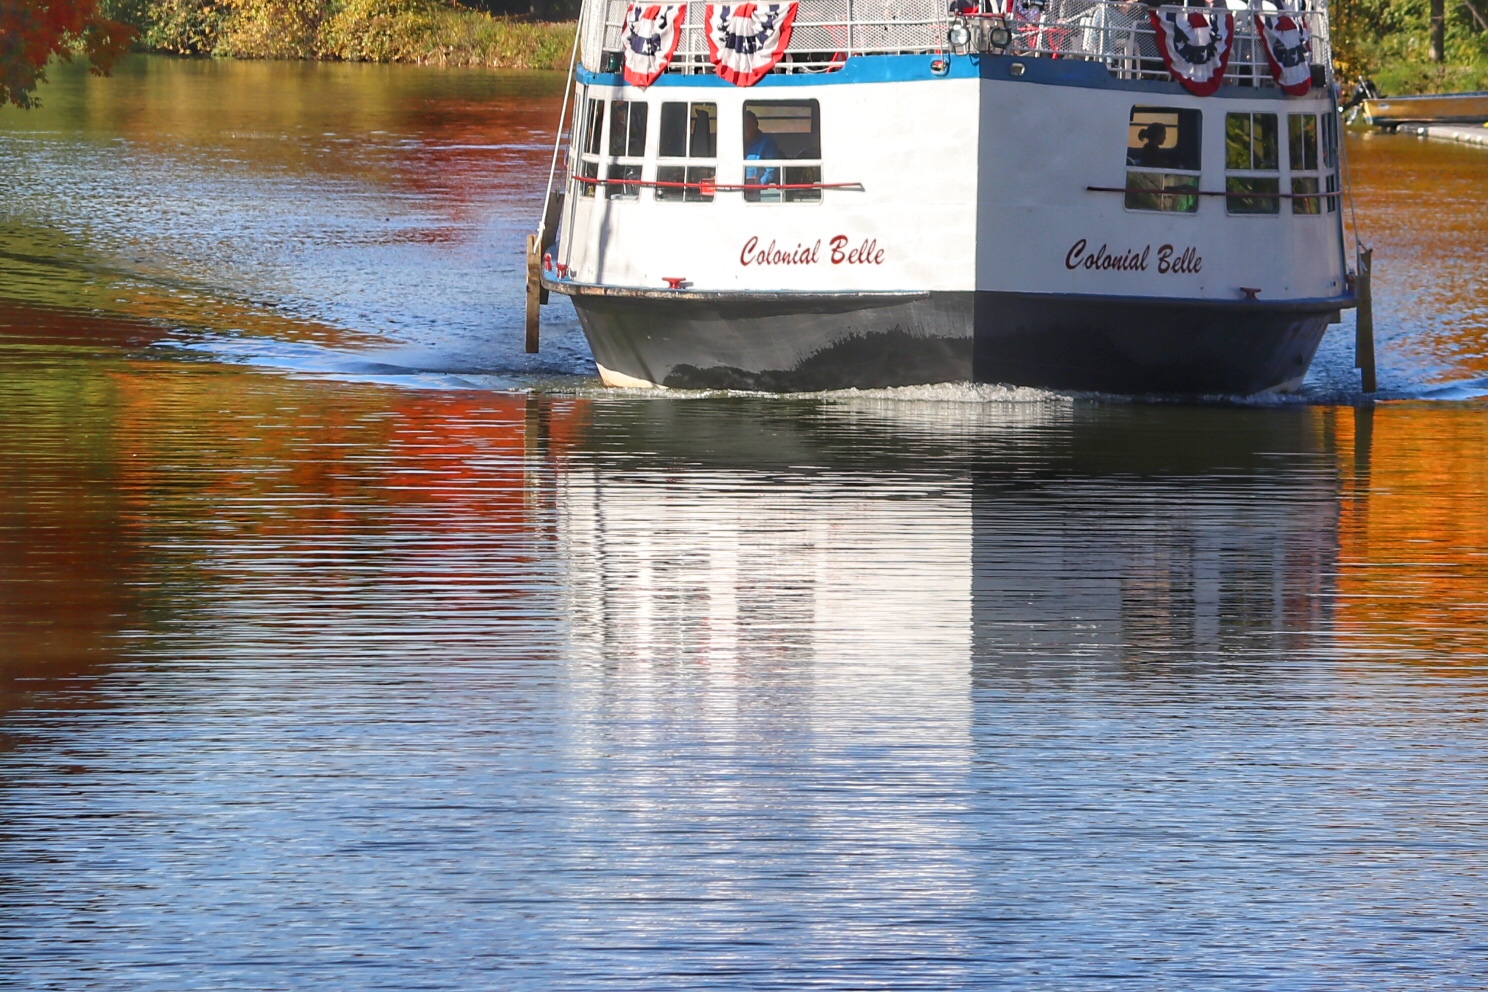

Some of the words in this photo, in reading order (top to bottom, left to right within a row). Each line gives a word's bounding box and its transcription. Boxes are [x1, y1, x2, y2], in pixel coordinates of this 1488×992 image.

[740, 236, 821, 267] Colonial
[829, 234, 885, 265] Belle
[1065, 238, 1150, 271] Colonial
[1157, 244, 1203, 274] Belle
